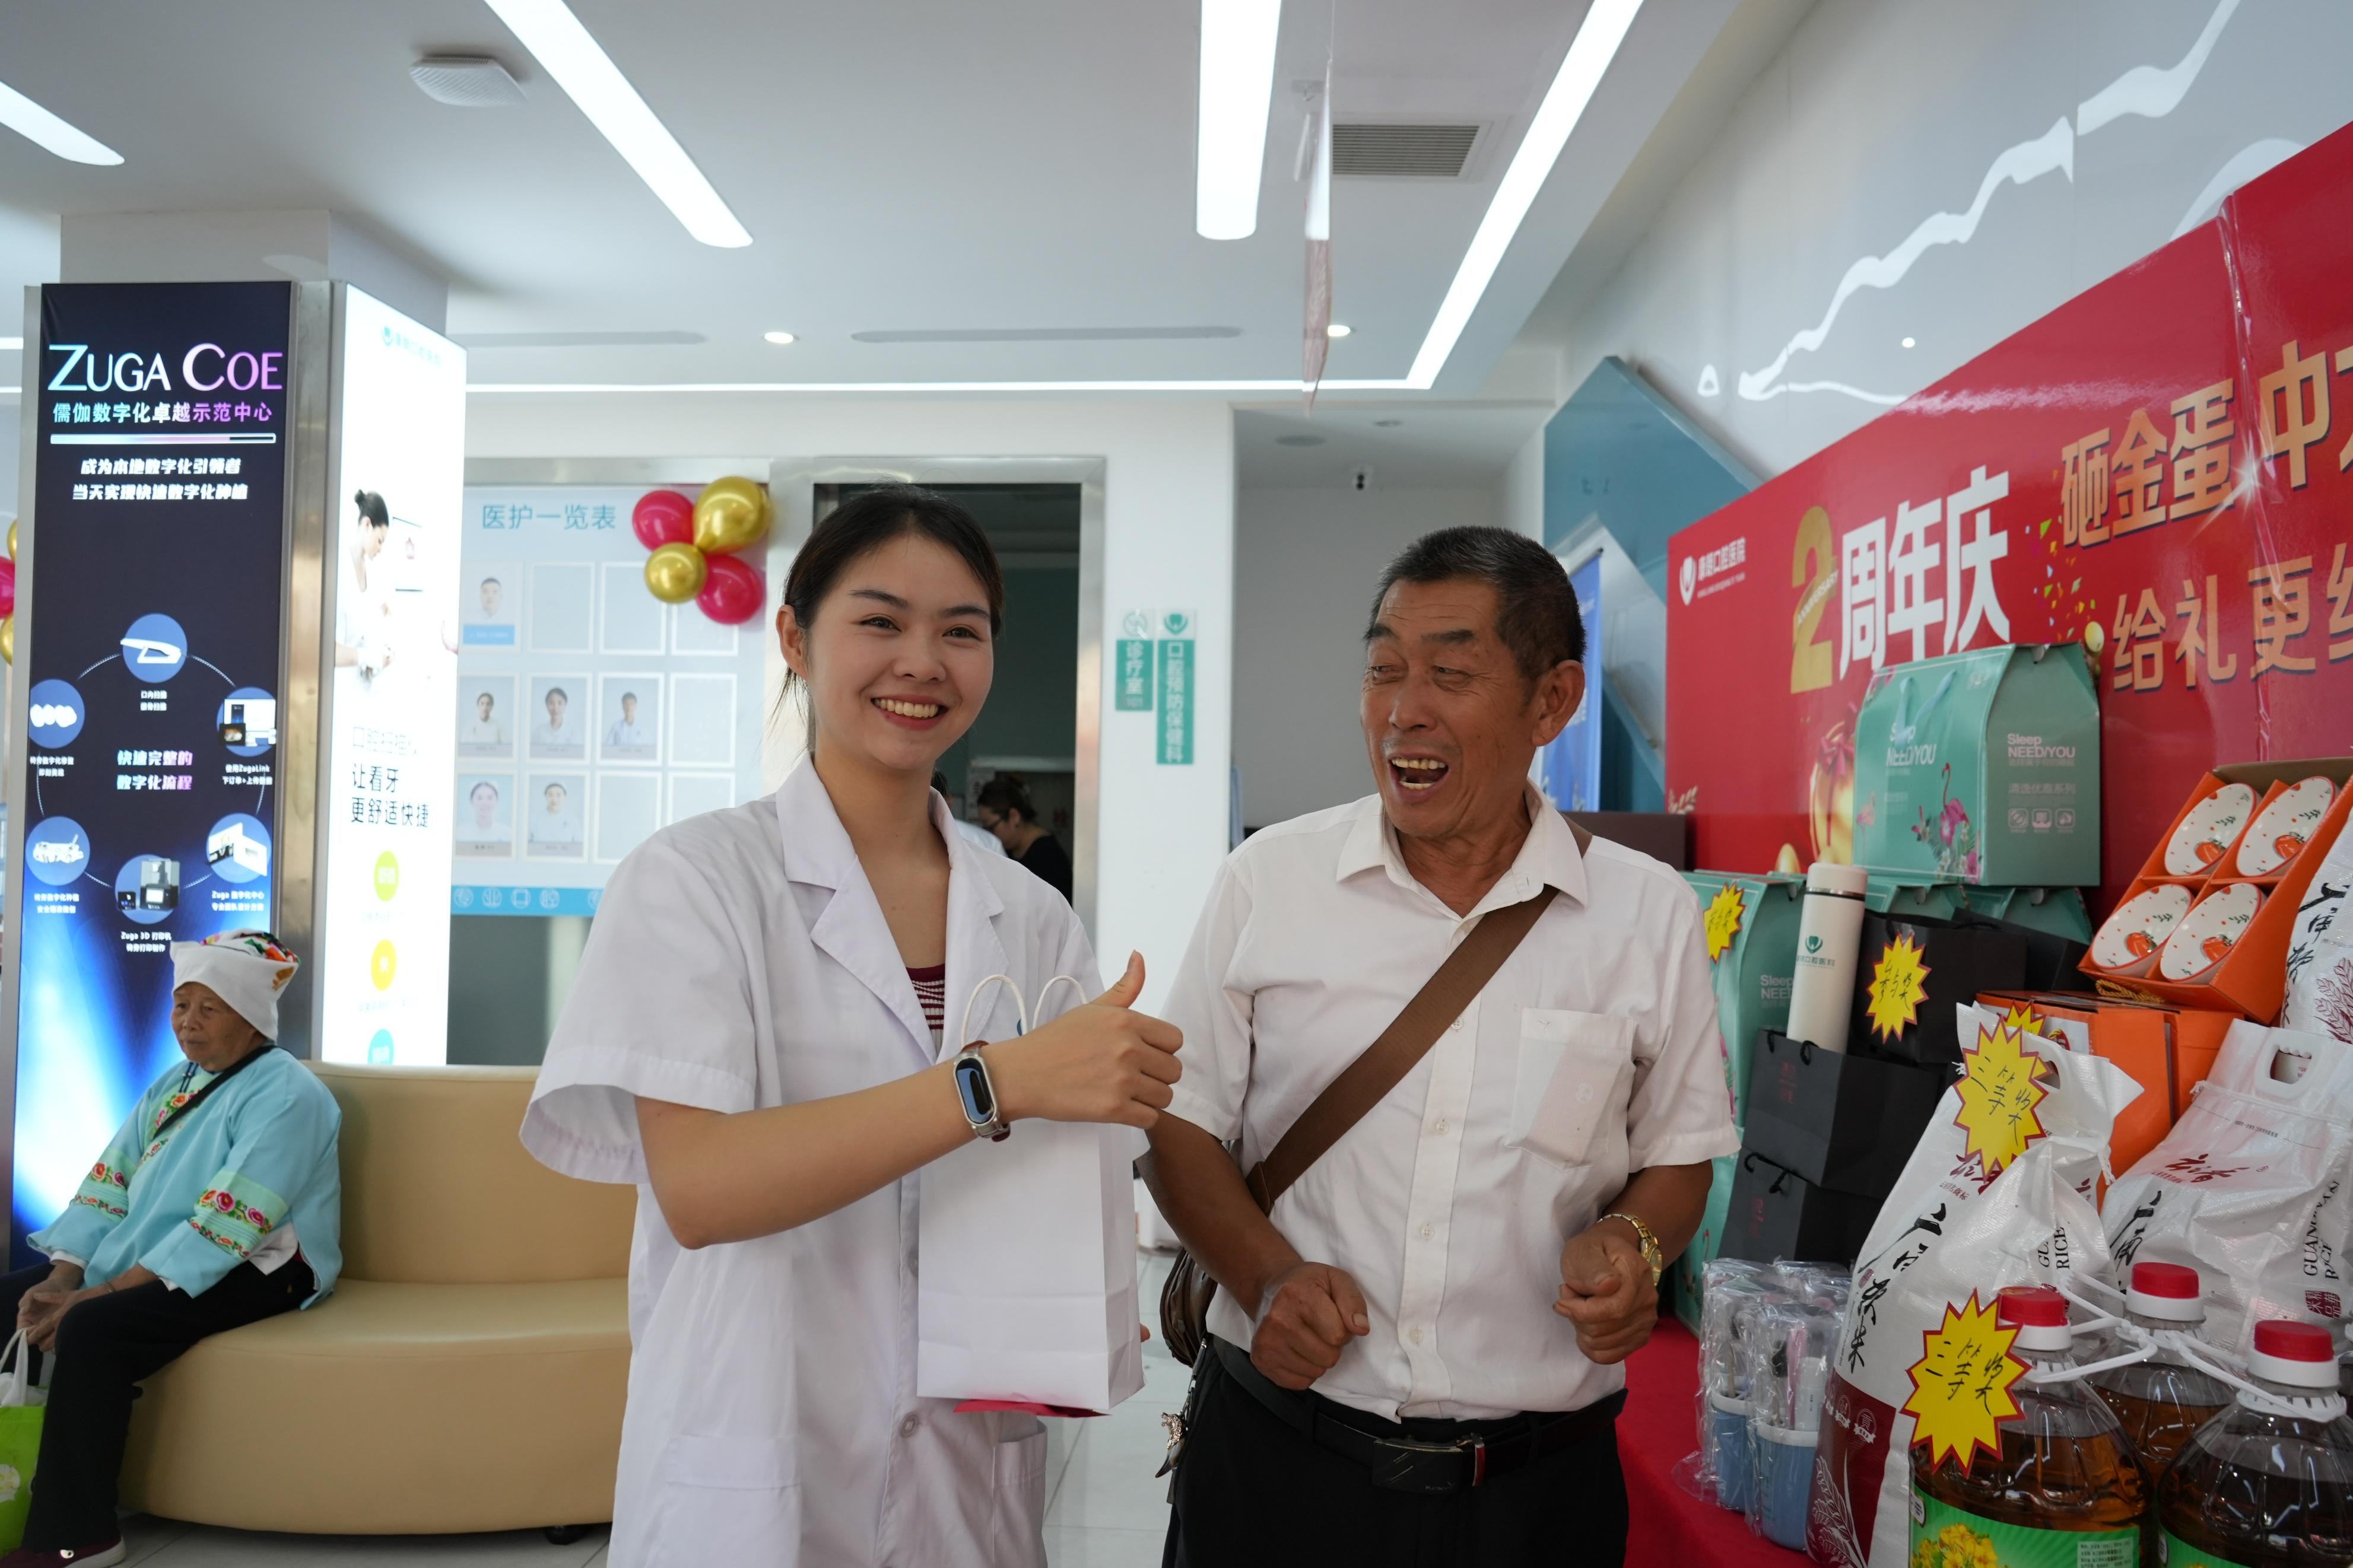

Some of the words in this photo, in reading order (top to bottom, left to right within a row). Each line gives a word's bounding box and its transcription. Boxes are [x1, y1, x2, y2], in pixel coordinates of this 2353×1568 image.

[53, 402, 272, 423] 儒伽数字化卓越示范中心
[81, 458, 241, 475] 成为本地数字化引领者
[2060, 378, 2234, 548] 砸金蛋
[72, 484, 248, 500] 当天实现快速数字化种植
[481, 504, 617, 530] 医护一览表
[2007, 733, 2042, 748] Sleep
[118, 750, 193, 766] 快速完整的
[116, 774, 193, 791] 数字化流程
[352, 763, 399, 793] 让看牙
[351, 797, 428, 828] 更舒适快捷
[1760, 975, 1793, 989] Sleep
[2055, 1226, 2071, 1270] RICE
